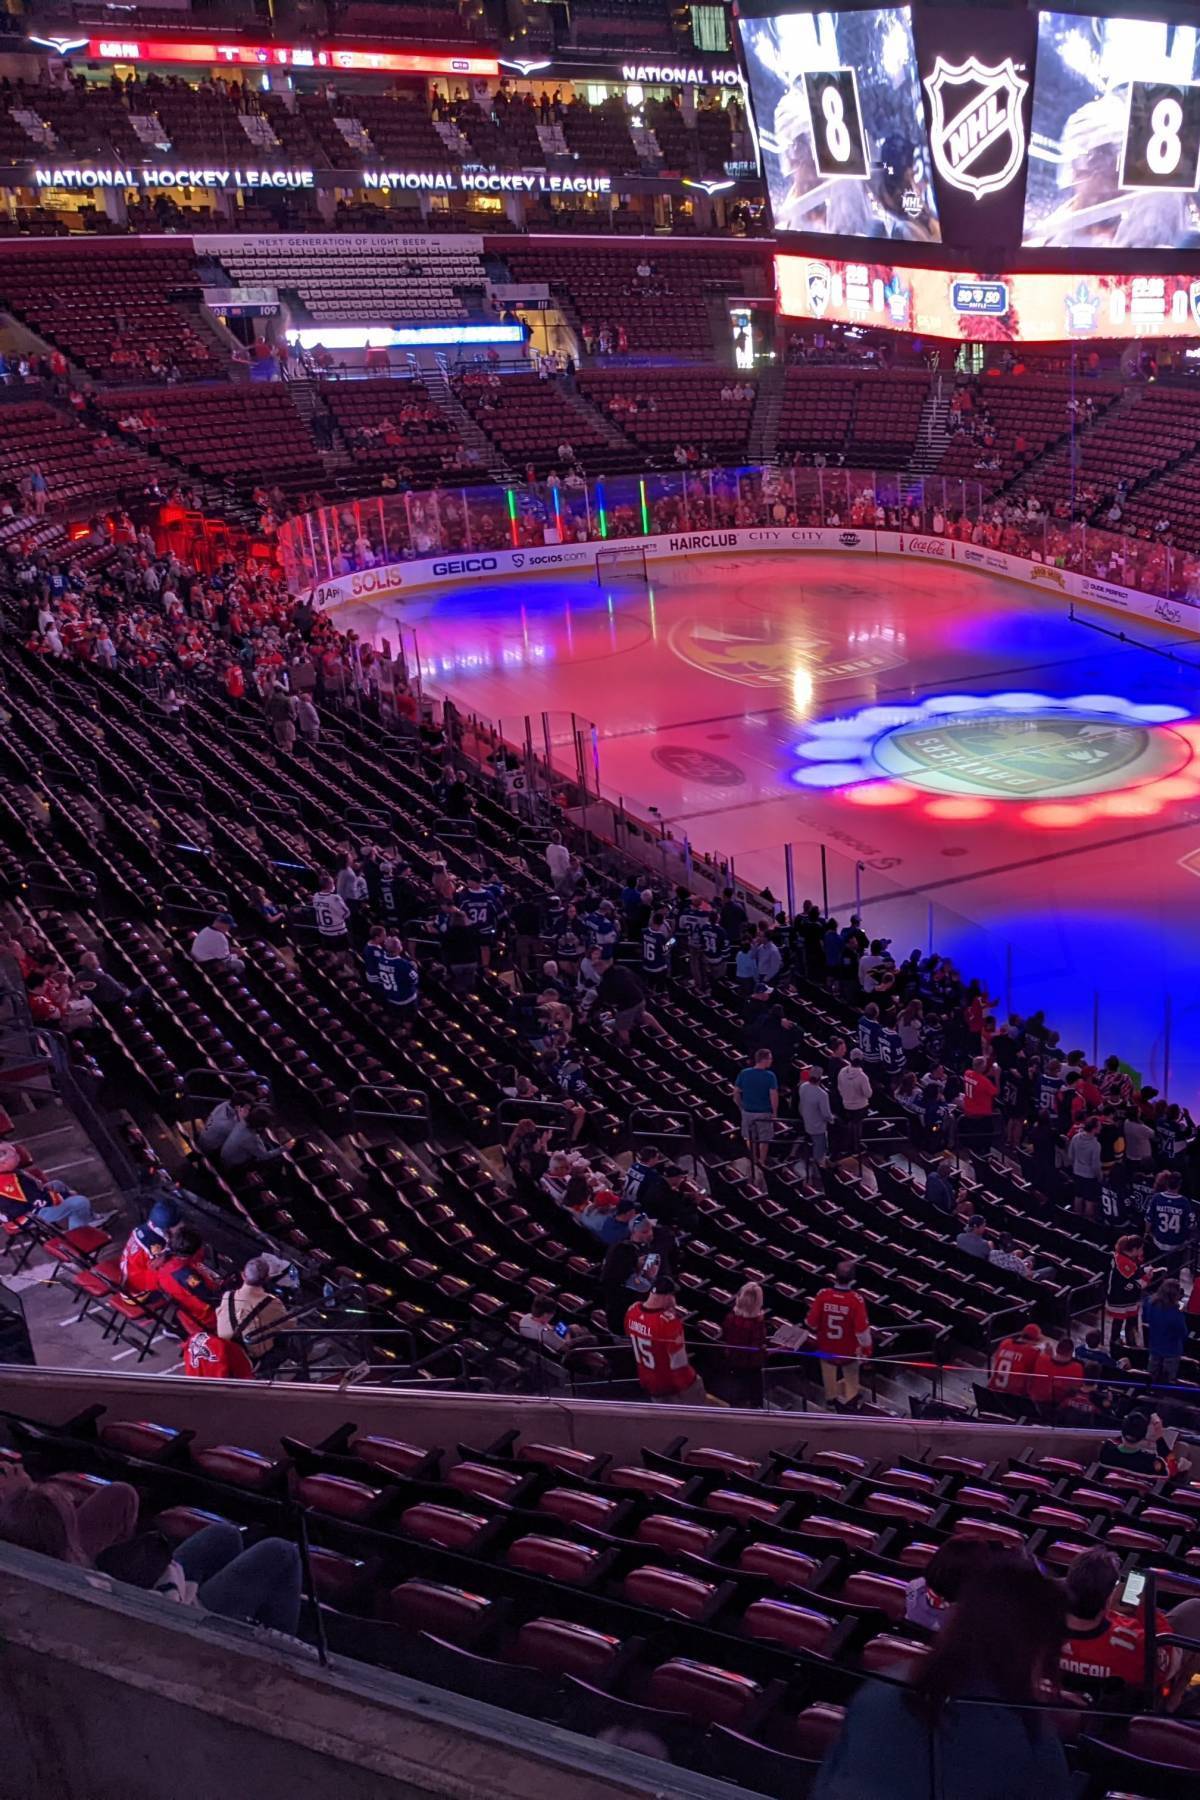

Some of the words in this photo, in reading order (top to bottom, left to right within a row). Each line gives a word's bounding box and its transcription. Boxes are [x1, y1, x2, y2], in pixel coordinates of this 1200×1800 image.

[622, 66, 708, 84] NATIONAL
[821, 86, 851, 162] 8
[948, 98, 1009, 168] NHL
[1146, 98, 1184, 174] 8
[36, 170, 139, 187] NATIONAL
[144, 171, 230, 188] HOCKEY
[235, 171, 315, 188] LEAGUE
[363, 172, 457, 190] NATIONAL
[461, 175, 534, 191] HOCKEY
[540, 176, 611, 193] LEAGUE
[901, 196, 923, 209] NHL
[258, 238, 283, 247] NEXT
[287, 238, 350, 247] GENERATION
[354, 238, 368, 247] OF
[371, 238, 399, 247] LIGHT
[402, 238, 427, 247] BEER
[259, 307, 278, 317] 109
[669, 533, 738, 551] HAIRCLUB
[749, 531, 781, 541] CITY
[791, 531, 823, 541] CITY
[432, 557, 498, 576] GEICO
[352, 567, 402, 595] SOLIS
[913, 735, 1029, 787] PANTHERS
[467, 907, 488, 924] 34
[1101, 1195, 1119, 1217] 91
[1158, 1212, 1181, 1234] 34
[826, 1314, 845, 1340] 5
[630, 1333, 656, 1370] 15
